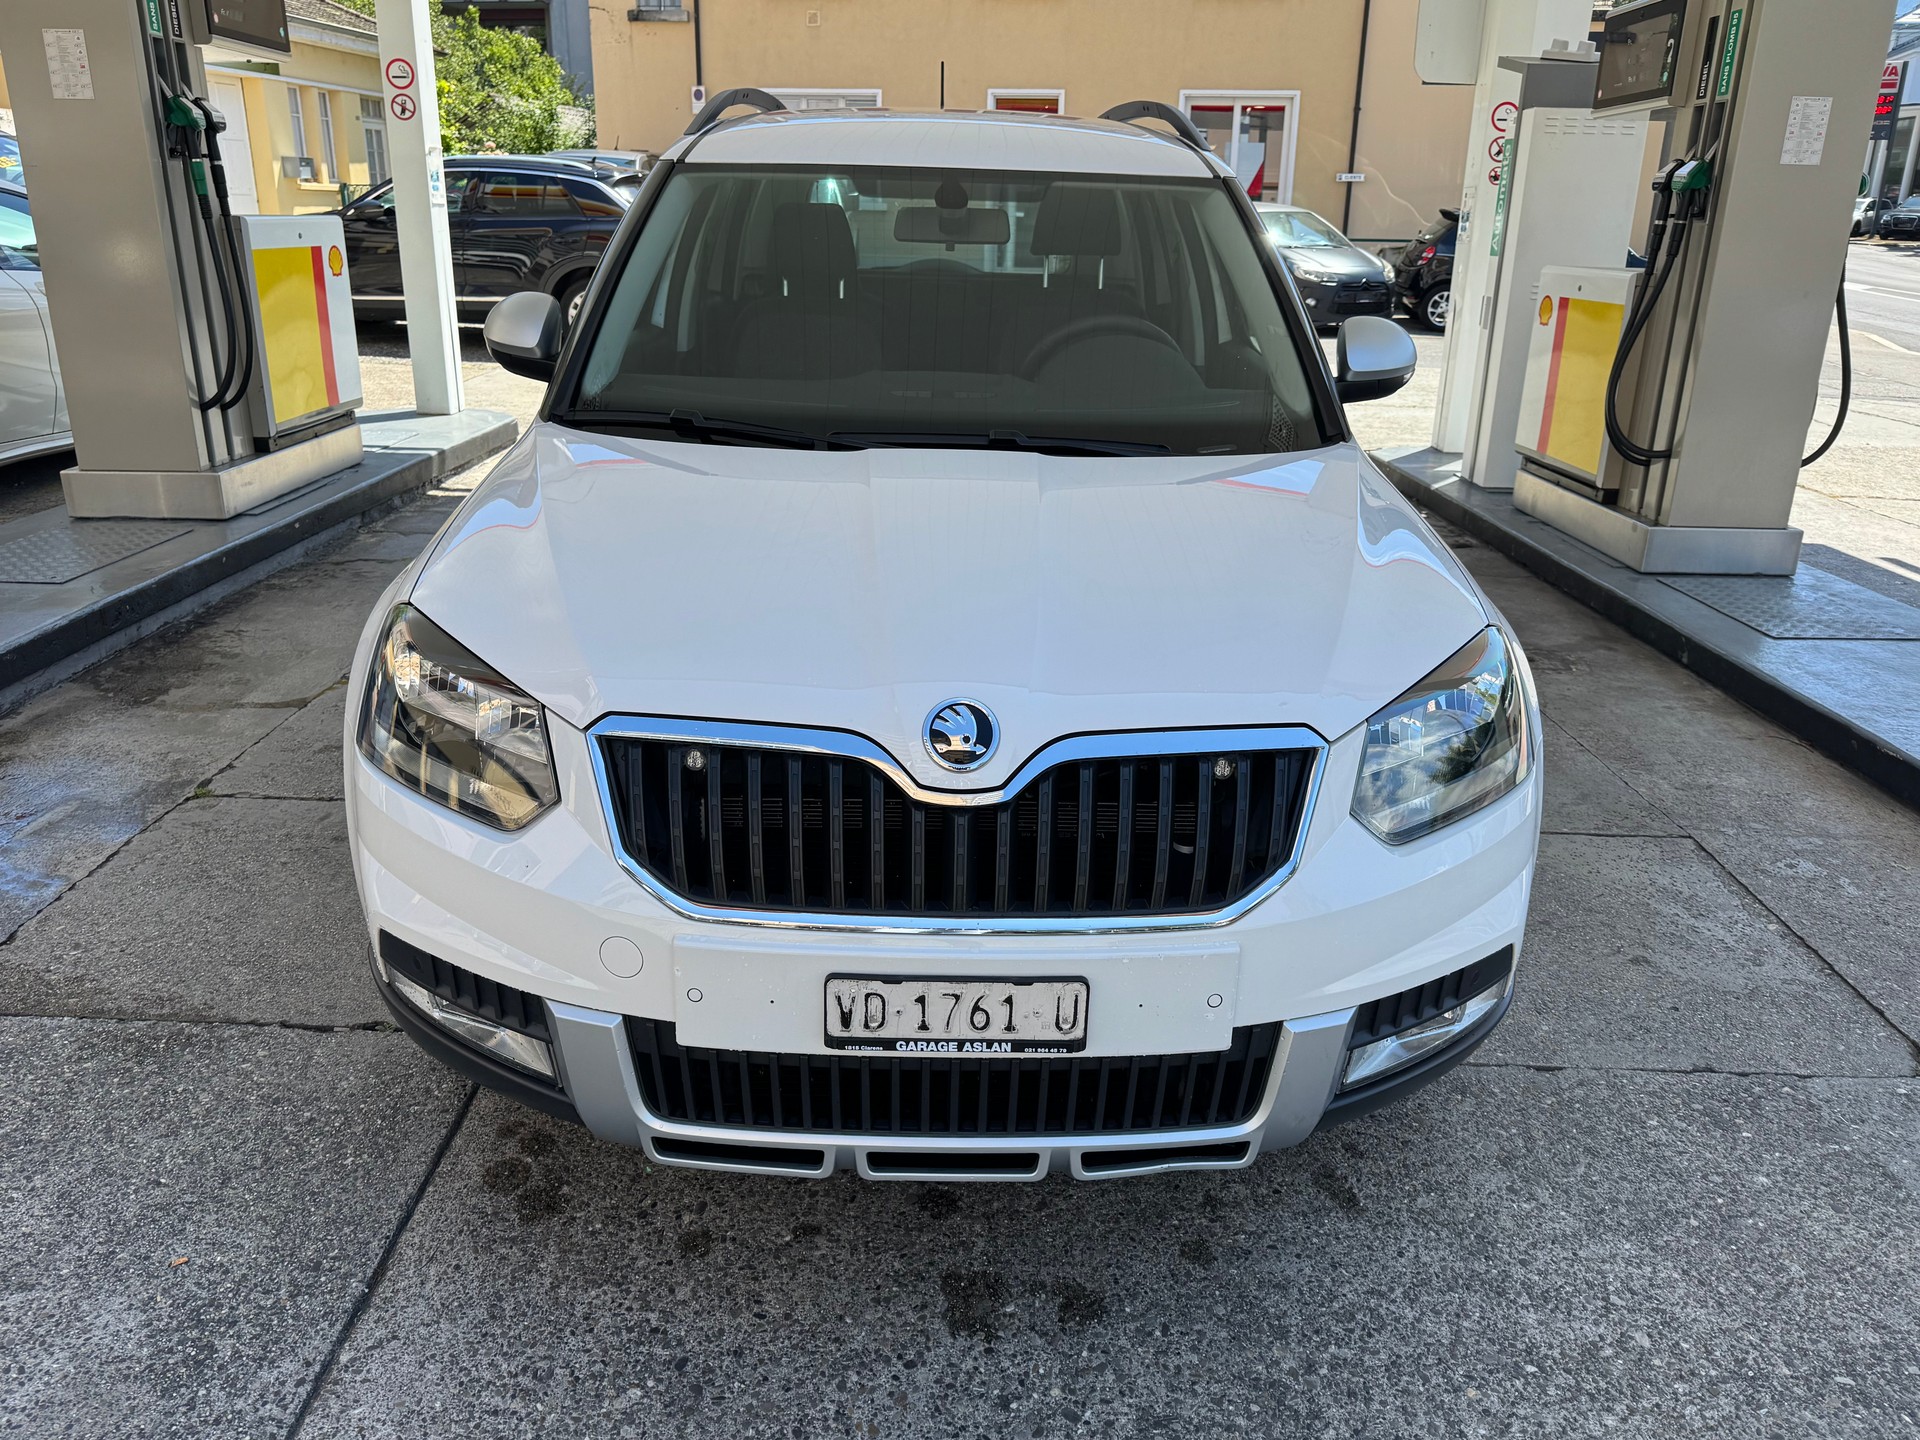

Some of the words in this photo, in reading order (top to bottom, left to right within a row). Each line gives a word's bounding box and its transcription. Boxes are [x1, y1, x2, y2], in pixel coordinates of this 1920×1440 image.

[150, 2, 159, 30] SANS
[170, 0, 180, 35] DIESEL
[1720, 65, 1730, 93] SANS
[1725, 26, 1737, 63] PLOMB
[1699, 61, 1710, 97] DIESEL
[1491, 144, 1512, 251] Automate
[835, 989, 888, 1032] VD
[913, 989, 1019, 1033] 1761
[1055, 990, 1081, 1034] U
[896, 1041, 958, 1052] GARAGE
[962, 1042, 1012, 1053] ASLAN
